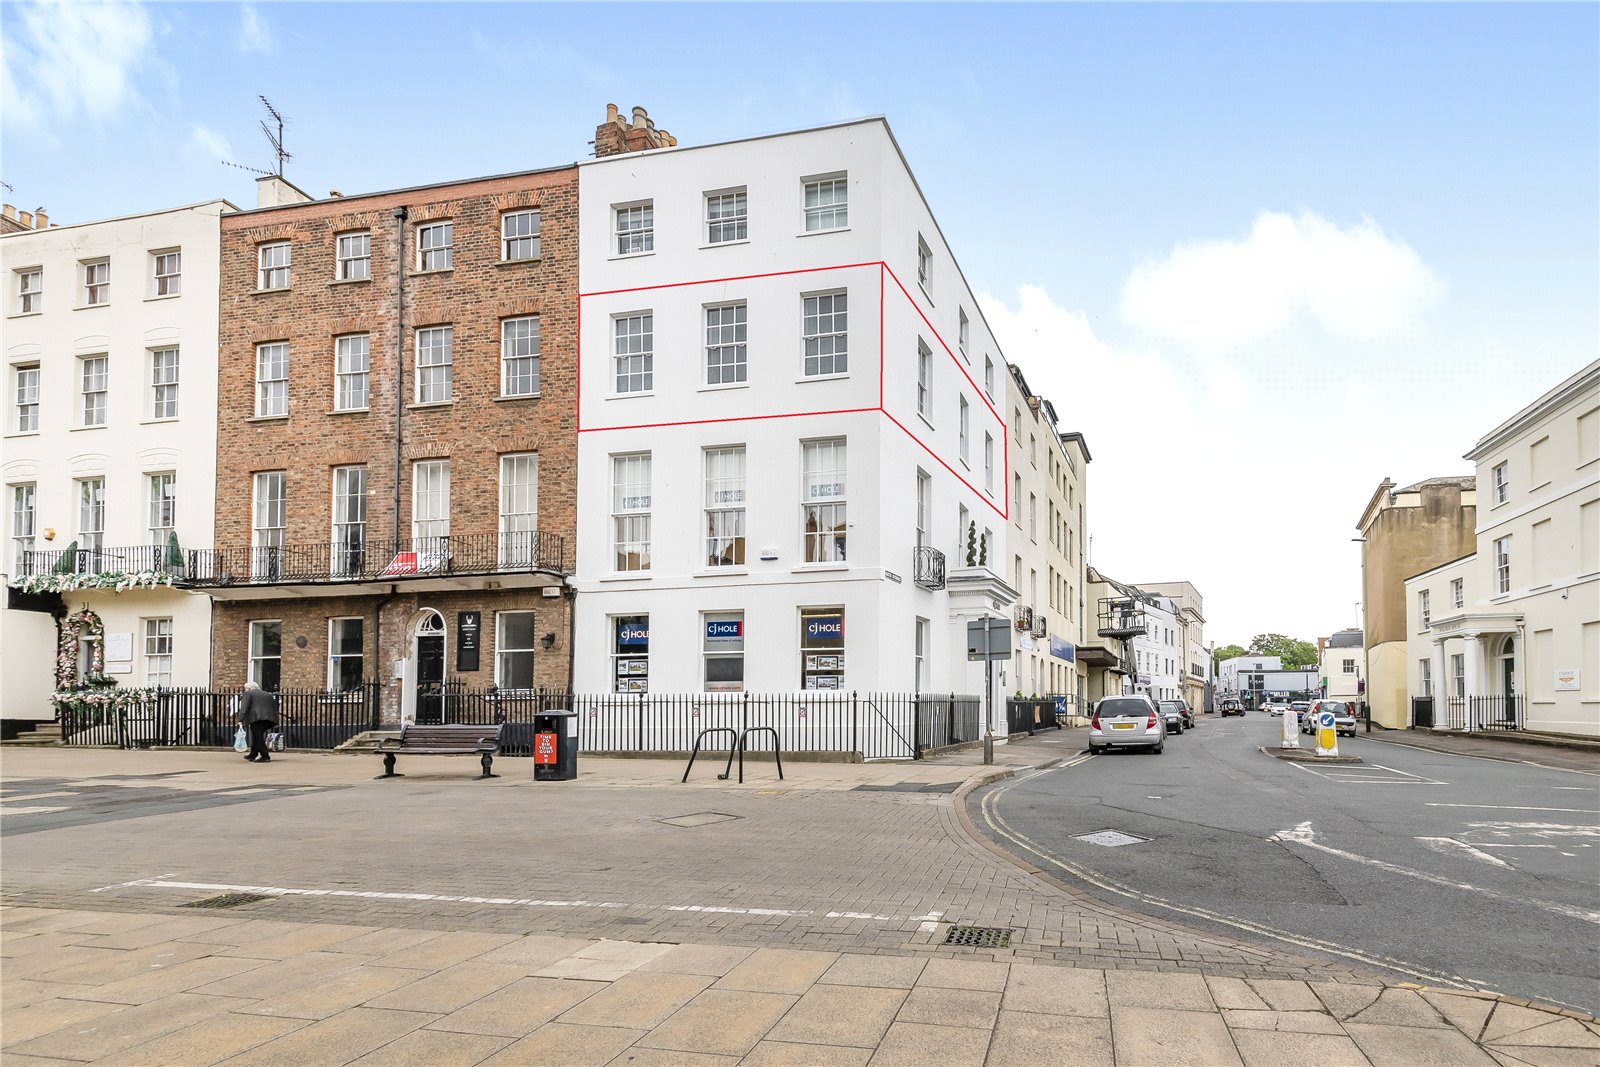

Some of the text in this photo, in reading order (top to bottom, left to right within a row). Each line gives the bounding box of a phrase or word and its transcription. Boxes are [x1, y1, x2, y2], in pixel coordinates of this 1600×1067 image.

[81, 601, 90, 610] 31
[717, 625, 738, 633] HOLE
[819, 623, 841, 632] HOLE
[630, 630, 650, 638] HOLE
